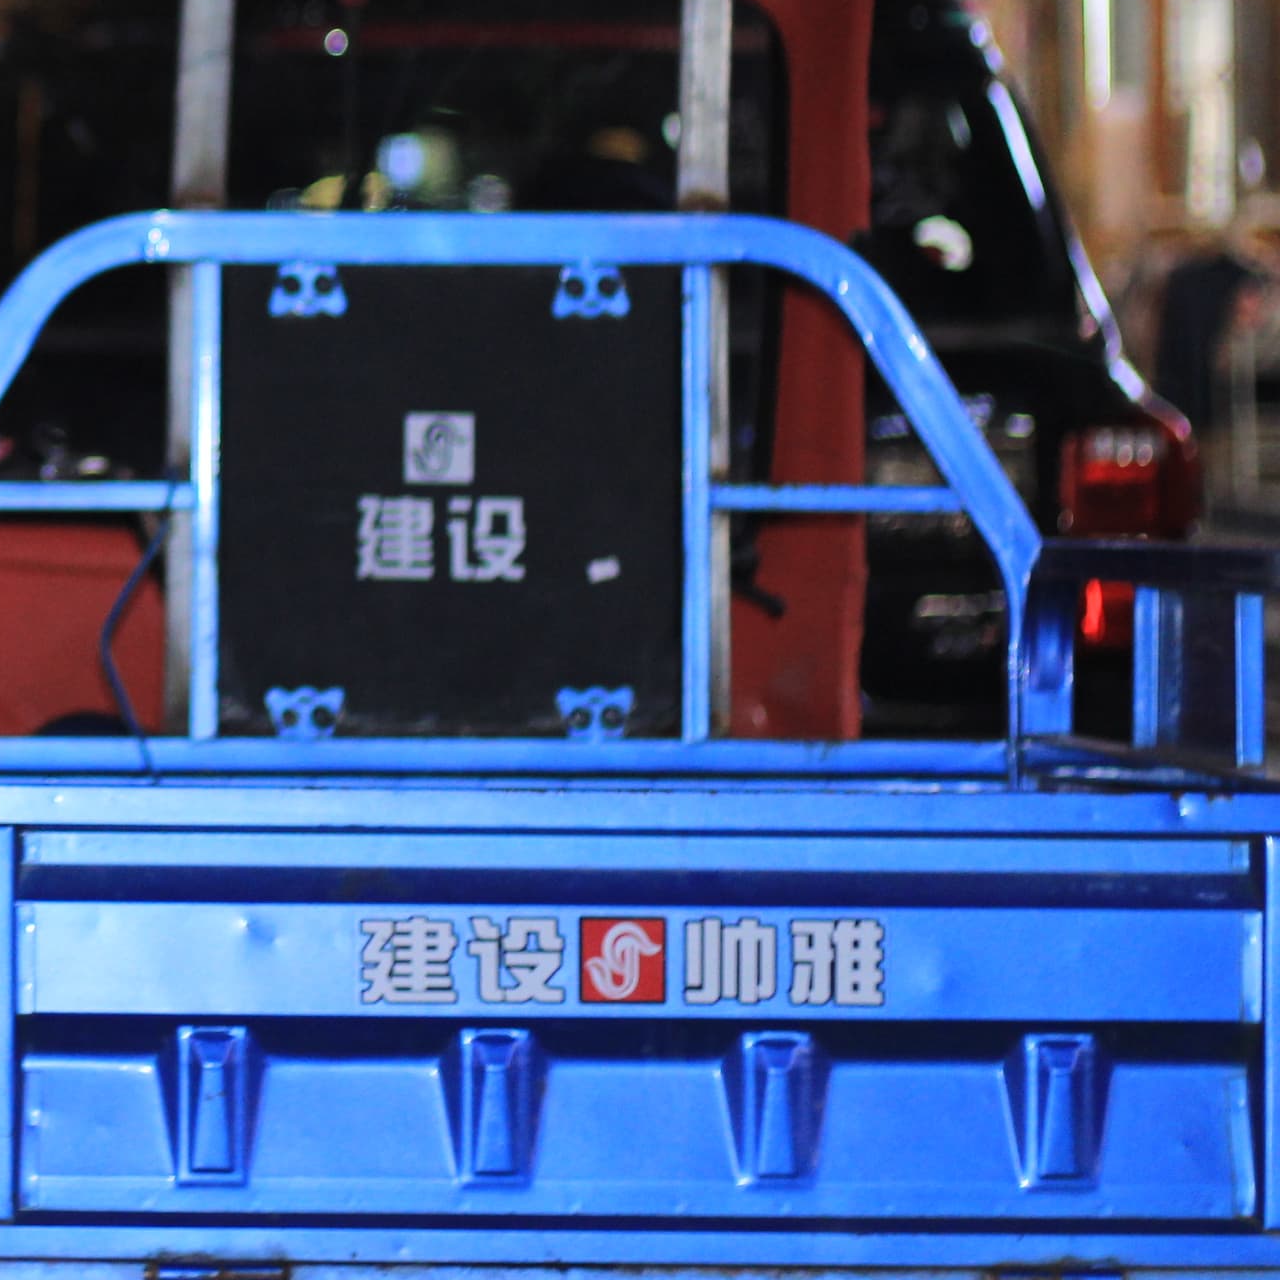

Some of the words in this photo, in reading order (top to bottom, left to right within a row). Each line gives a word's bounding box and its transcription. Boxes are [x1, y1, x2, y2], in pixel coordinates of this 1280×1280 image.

[355, 495, 527, 581] 建设
[359, 916, 566, 1006] 建设
[683, 917, 887, 1008] 帅雅
